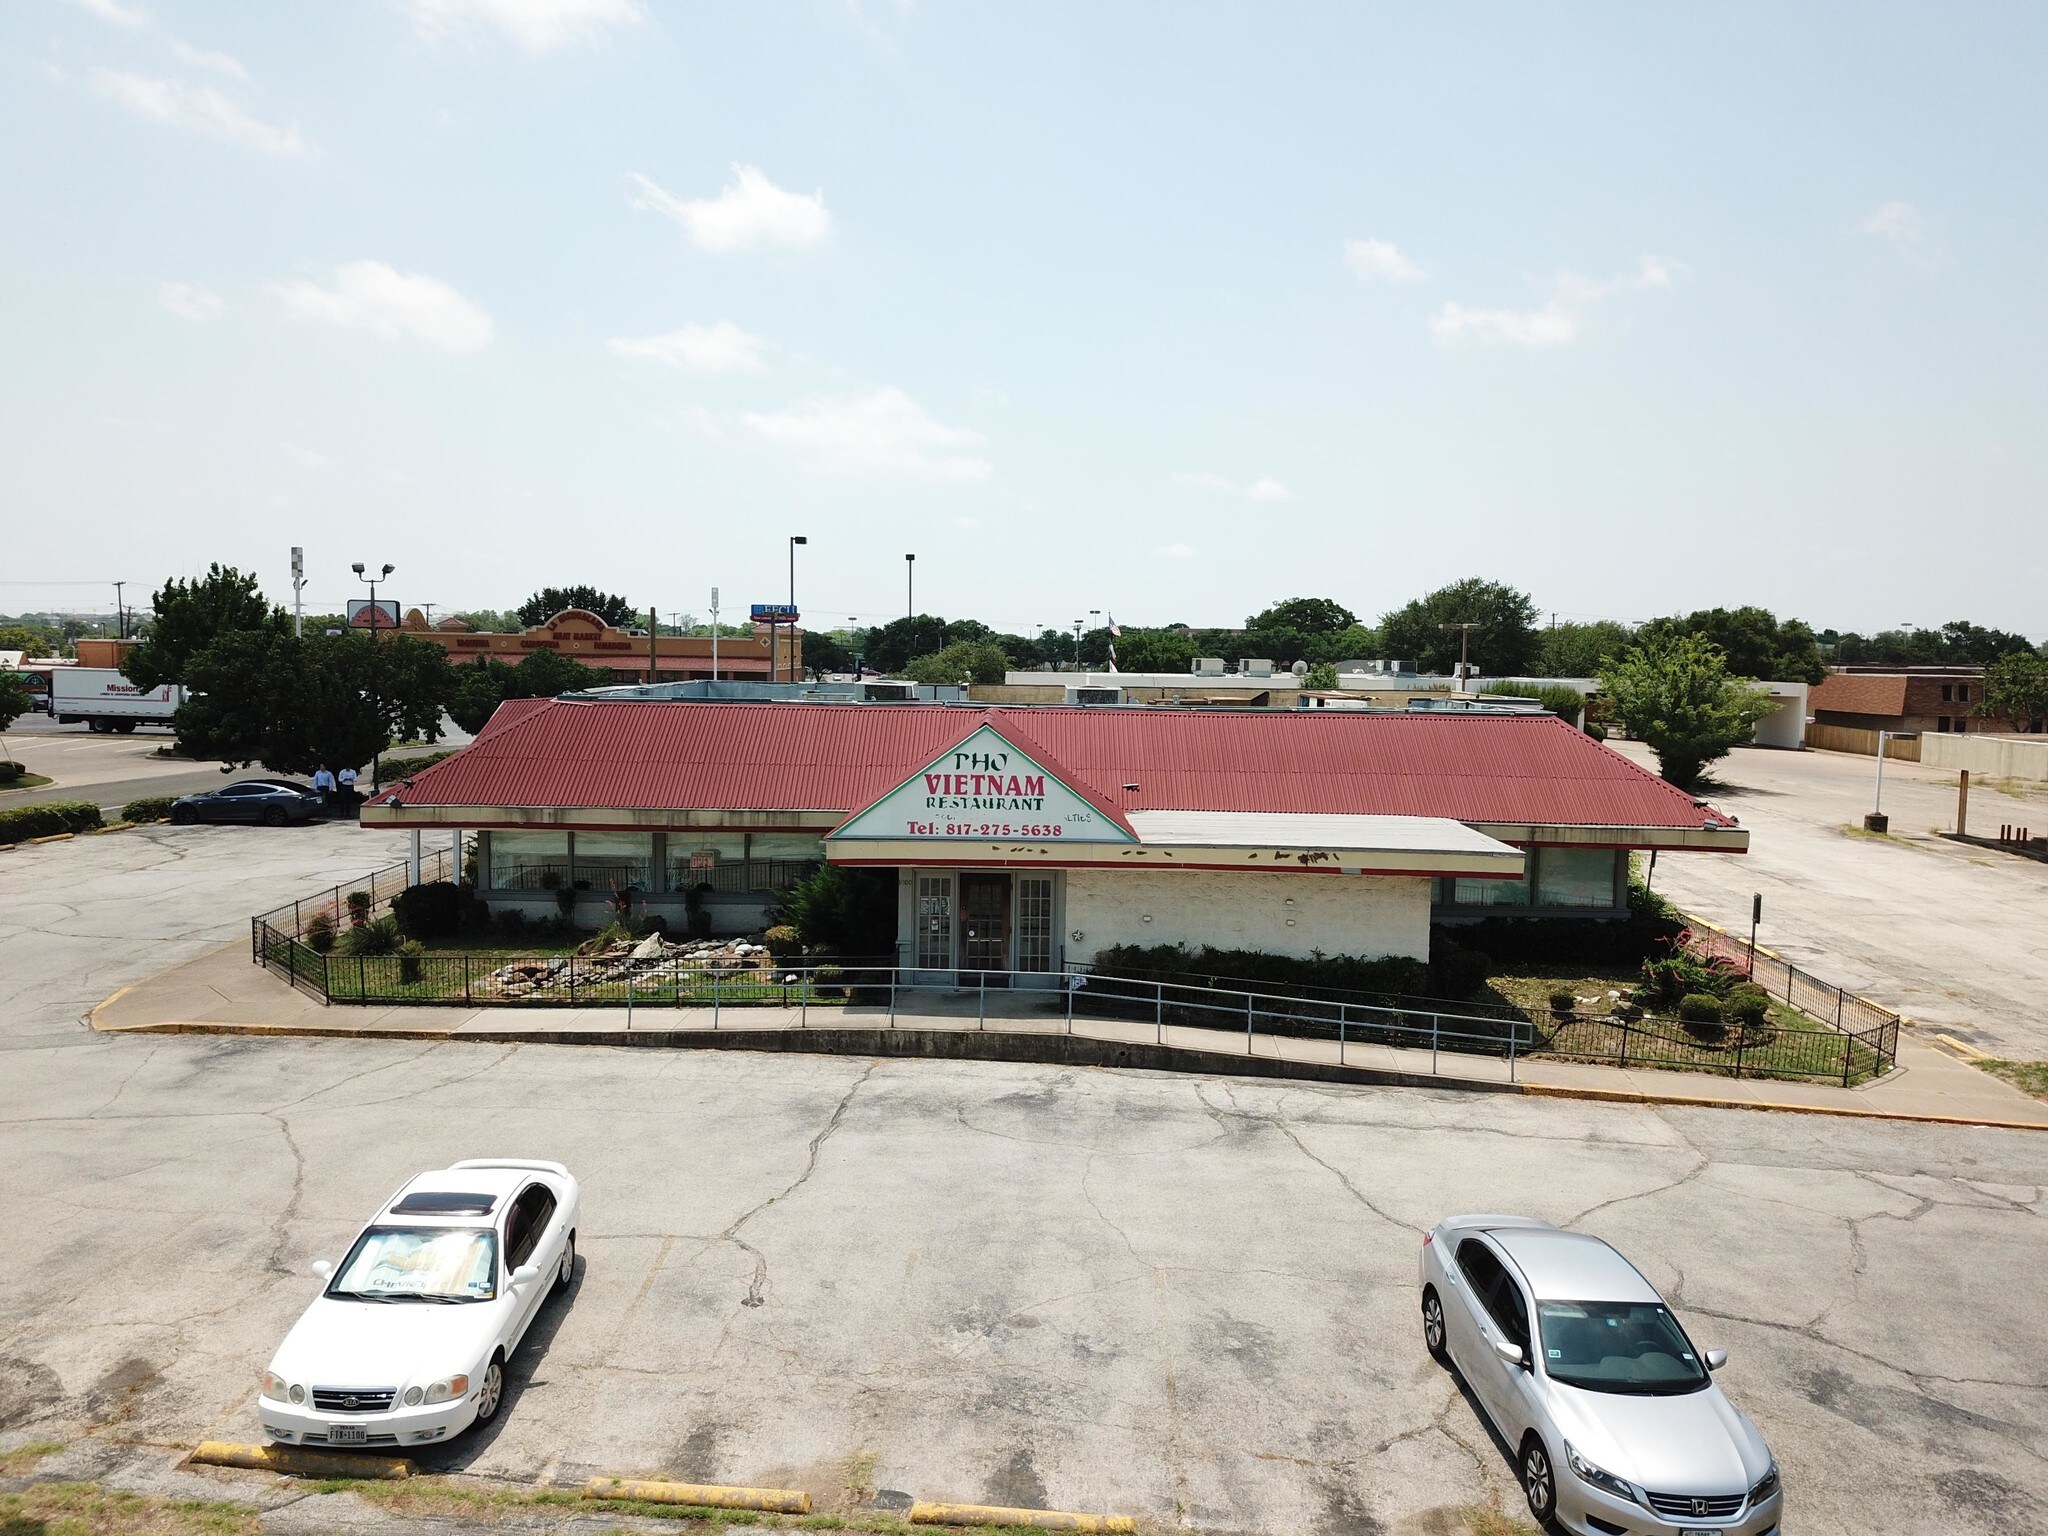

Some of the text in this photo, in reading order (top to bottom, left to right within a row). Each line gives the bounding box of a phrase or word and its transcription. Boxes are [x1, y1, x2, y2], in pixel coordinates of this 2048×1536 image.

[106, 684, 140, 692] Mission
[924, 773, 1045, 797] VIETNAM
[926, 796, 1044, 811] RESTAURANT
[907, 821, 1062, 836] Tel: 817-275-5638
[692, 856, 713, 867] OPEN
